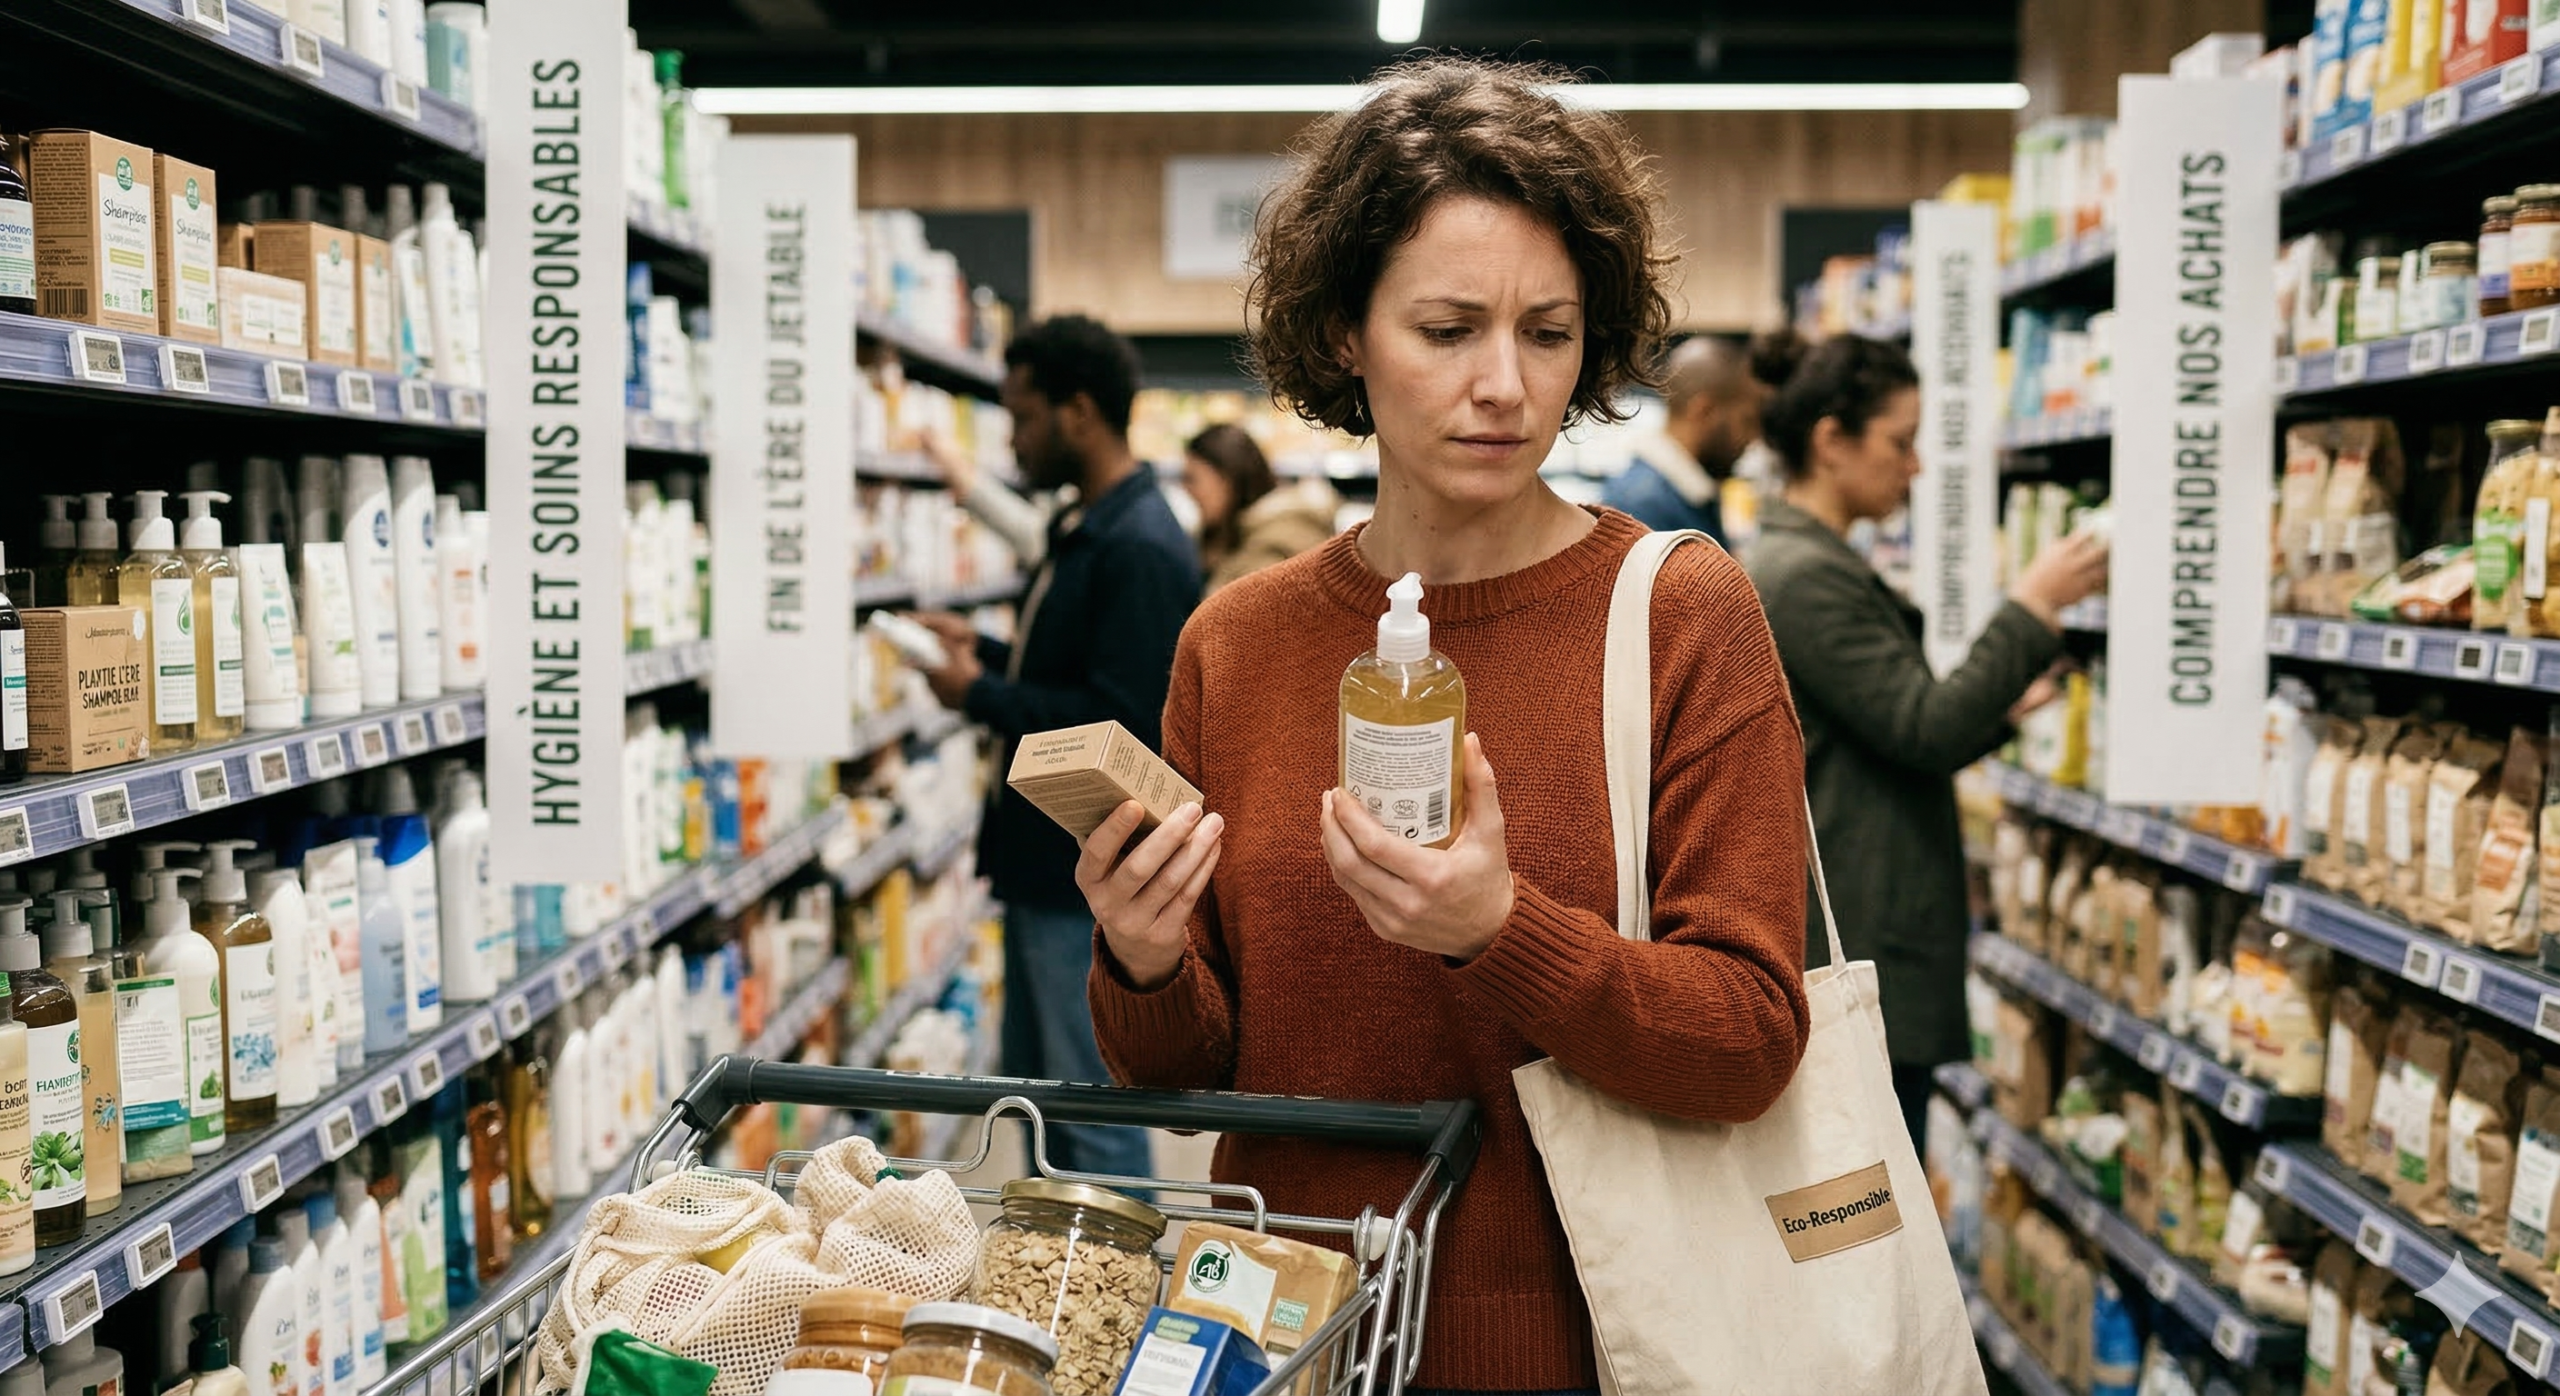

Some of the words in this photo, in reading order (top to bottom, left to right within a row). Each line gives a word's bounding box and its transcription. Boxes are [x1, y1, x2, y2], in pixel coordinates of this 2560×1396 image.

[532, 60, 580, 405] RESPONSABLES
[2181, 152, 2225, 309] ACHATS
[767, 204, 804, 347] JETABLE
[767, 358, 804, 406] DU
[2179, 327, 2220, 404] NOS
[532, 426, 580, 525] SOINS
[767, 525, 804, 565] DE
[2171, 425, 2218, 703] COMPRENDRE
[532, 574, 580, 620] ET
[766, 577, 804, 634] FIN
[517, 669, 581, 825] HYGIÈNE
[1782, 1187, 1891, 1234] Eco-Responsible
